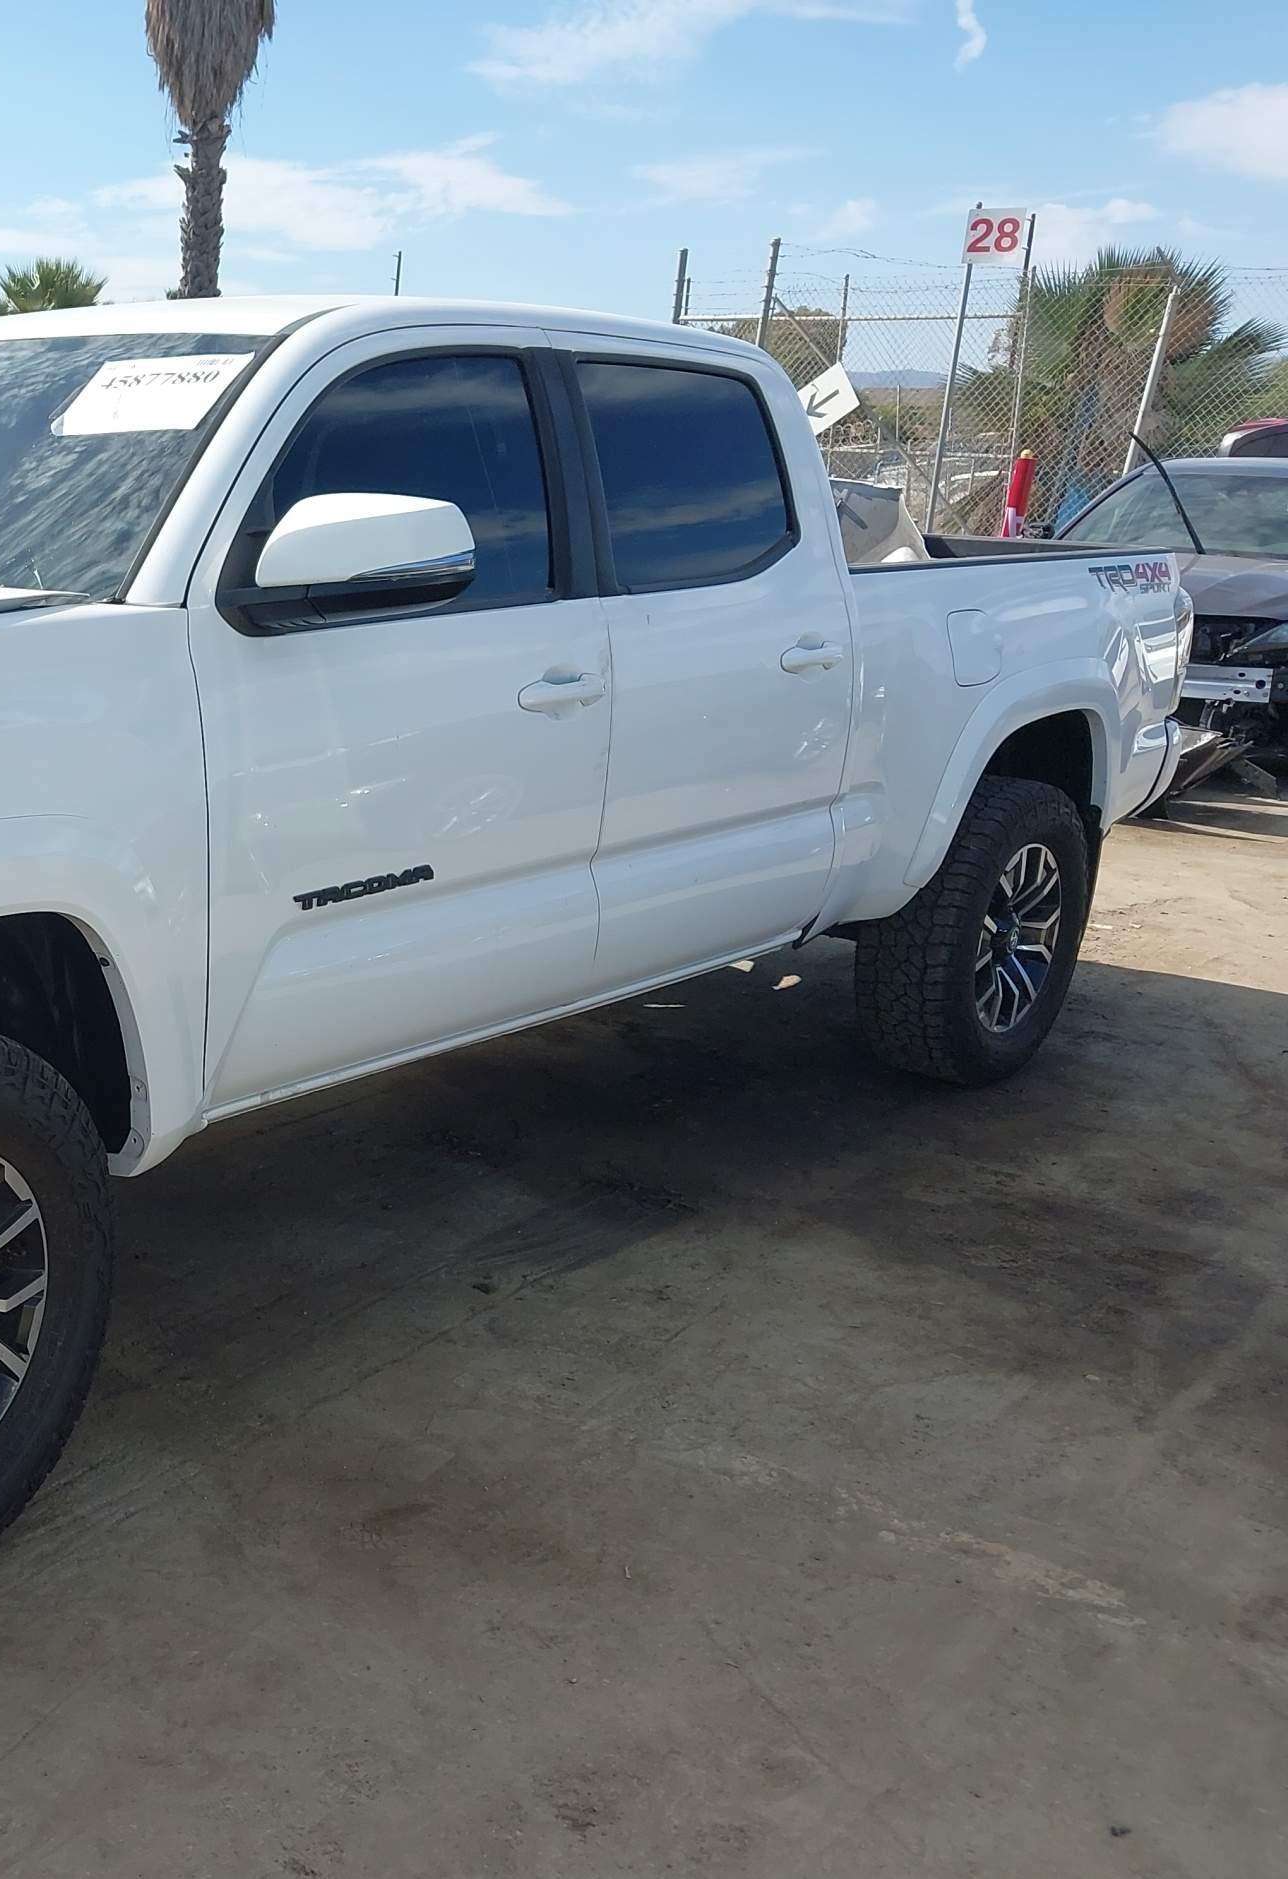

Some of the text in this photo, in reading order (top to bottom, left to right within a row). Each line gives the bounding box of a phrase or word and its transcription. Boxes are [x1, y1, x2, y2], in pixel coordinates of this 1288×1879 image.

[966, 217, 1021, 253] 28
[100, 369, 221, 390] 45877880
[1139, 582, 1172, 594] SPORT
[292, 863, 435, 911] TACOMA
